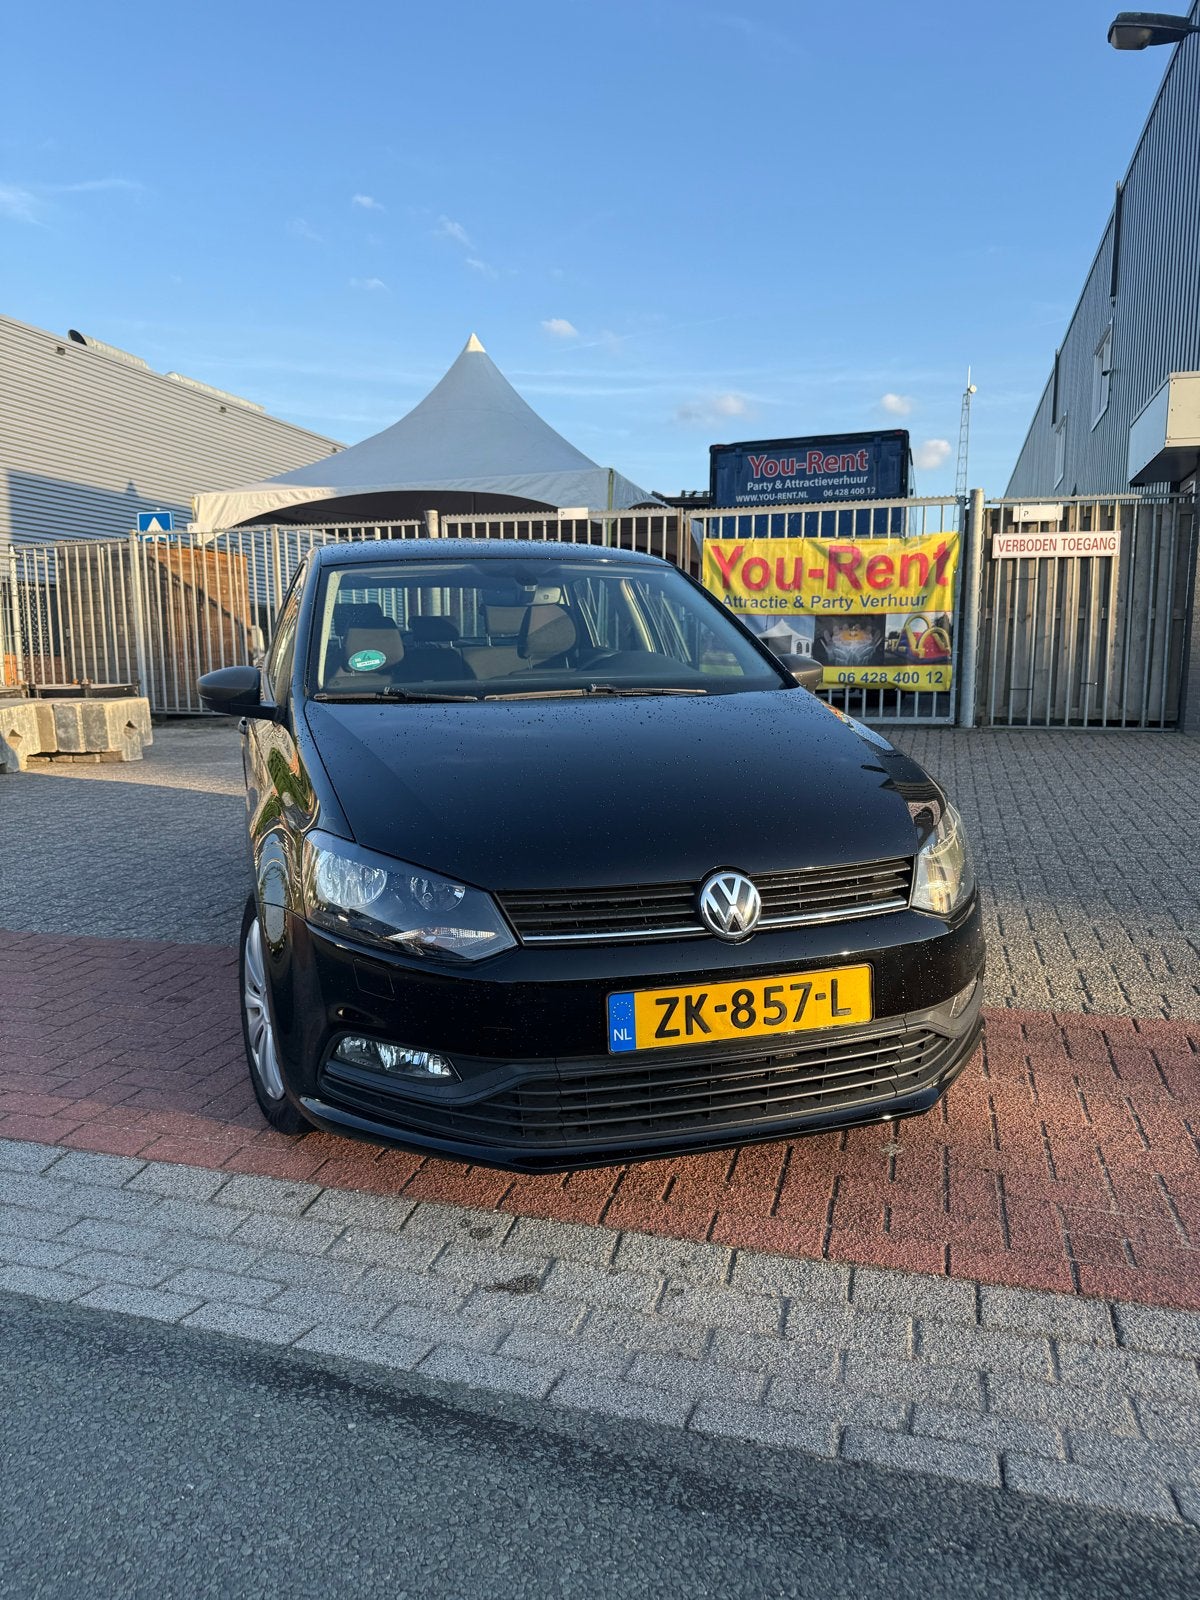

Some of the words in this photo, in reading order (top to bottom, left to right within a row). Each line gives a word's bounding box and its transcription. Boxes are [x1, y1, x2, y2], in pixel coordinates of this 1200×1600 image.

[748, 449, 869, 479] You-Rent
[747, 481, 773, 492] Party
[775, 480, 783, 489] &
[784, 475, 868, 489] Attractieverhuur
[823, 489, 833, 497] 06
[834, 488, 849, 496] 428
[850, 487, 865, 495] 400
[998, 539, 1057, 552] VERBODEN
[1062, 537, 1116, 551] TOEGANG
[711, 541, 951, 591] You-Rent
[723, 595, 788, 609] Attractie
[793, 595, 804, 608] &
[811, 595, 854, 611] Party
[859, 593, 928, 608] Verhuur
[837, 672, 855, 684] 06
[860, 671, 888, 684] 428
[893, 671, 920, 684] 400
[926, 671, 943, 684] 12
[655, 978, 851, 1039] ZK-857-L
[613, 1028, 632, 1042] NL
